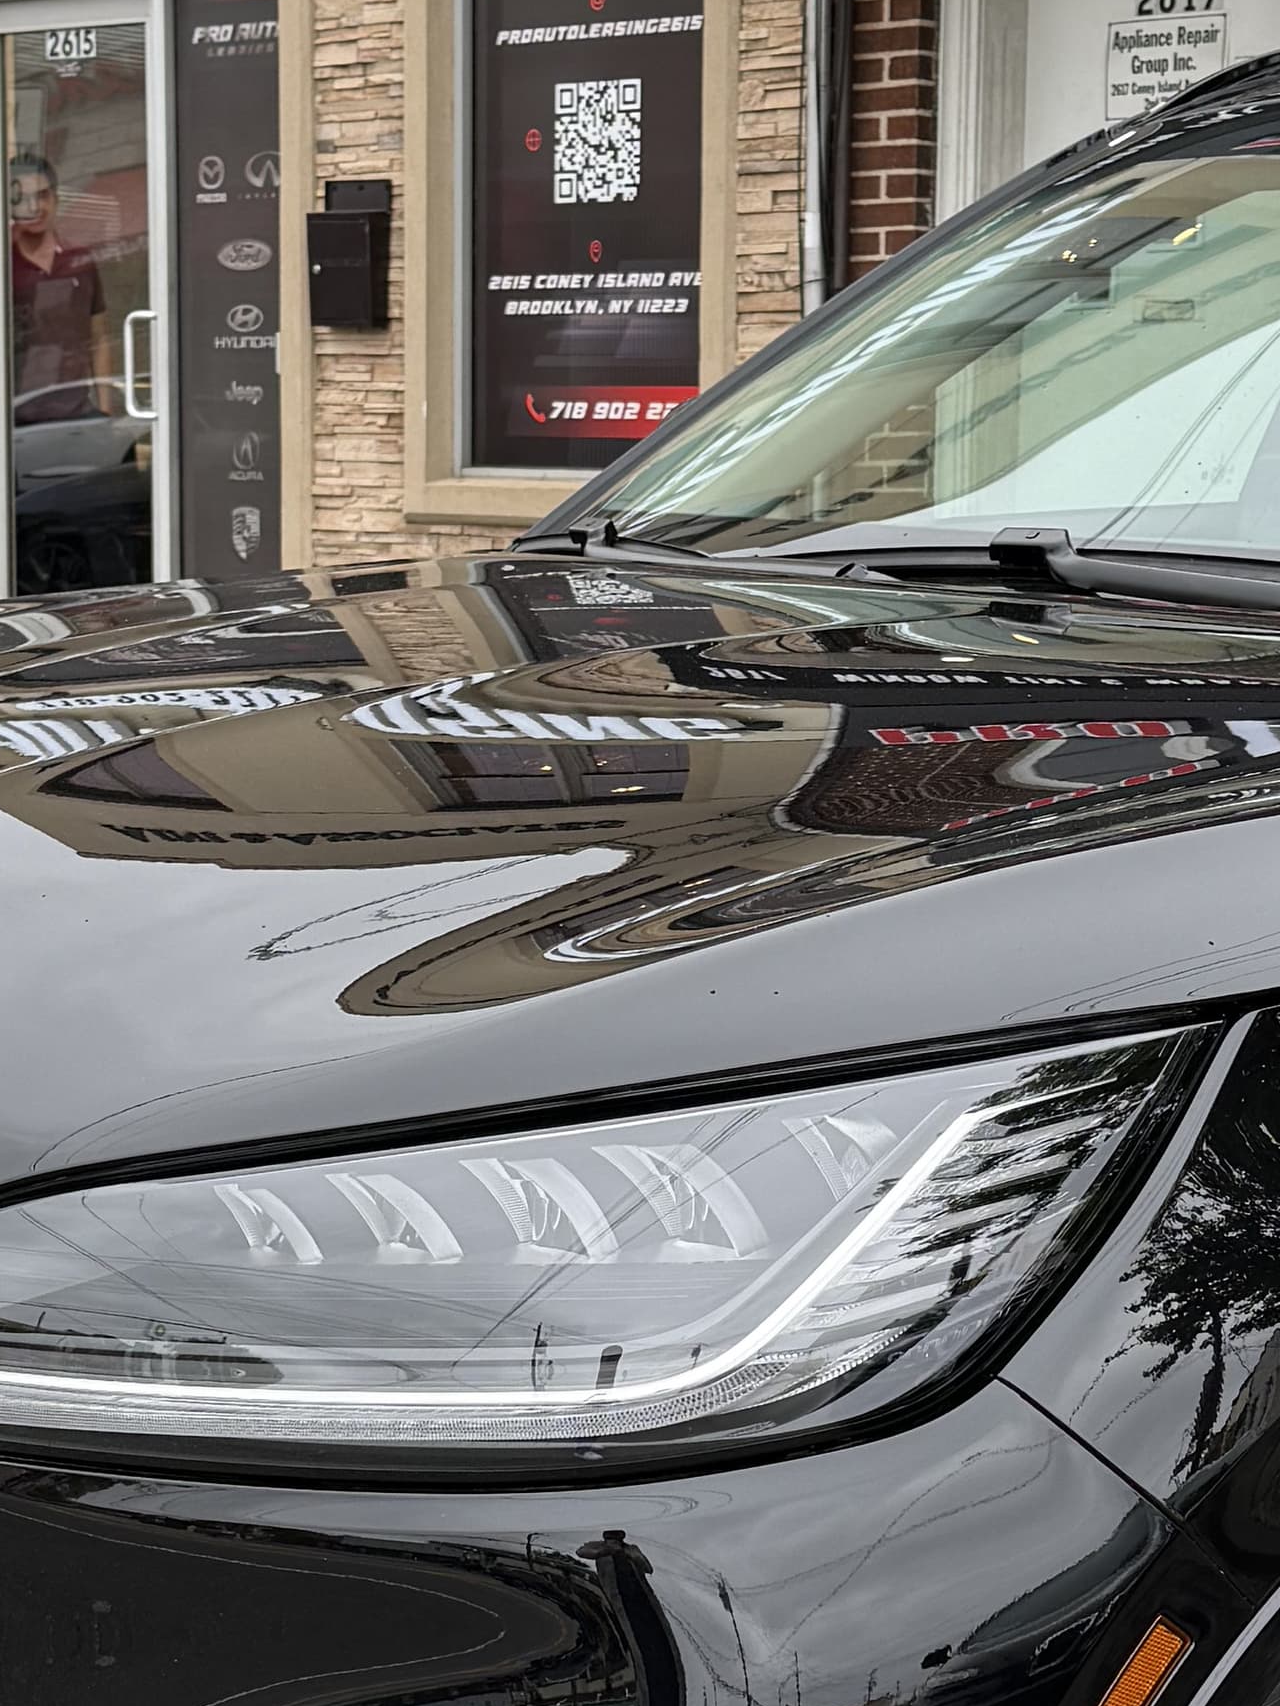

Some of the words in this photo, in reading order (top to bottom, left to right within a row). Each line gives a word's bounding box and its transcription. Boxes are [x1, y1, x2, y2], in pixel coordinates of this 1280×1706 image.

[192, 24, 234, 44] PRO
[235, 20, 279, 42] AUT
[495, 14, 704, 46] PROAUTOLEASING2615
[1112, 28, 1173, 53] Appliance
[1178, 24, 1221, 48] Repair
[49, 29, 94, 57] 2615
[1132, 54, 1169, 76] Group
[1173, 52, 1196, 71] Inc.
[1131, 82, 1155, 96] Coney
[488, 274, 531, 290] 2615
[534, 273, 590, 289] CONEY
[596, 272, 664, 288] ISLAND
[668, 271, 703, 287] AVE
[504, 299, 603, 315] BROOKLYN,
[608, 298, 633, 314] NY
[636, 298, 689, 313] 11223
[549, 402, 588, 420] 718
[592, 402, 640, 420] 902
[227, 470, 264, 481] ACURA
